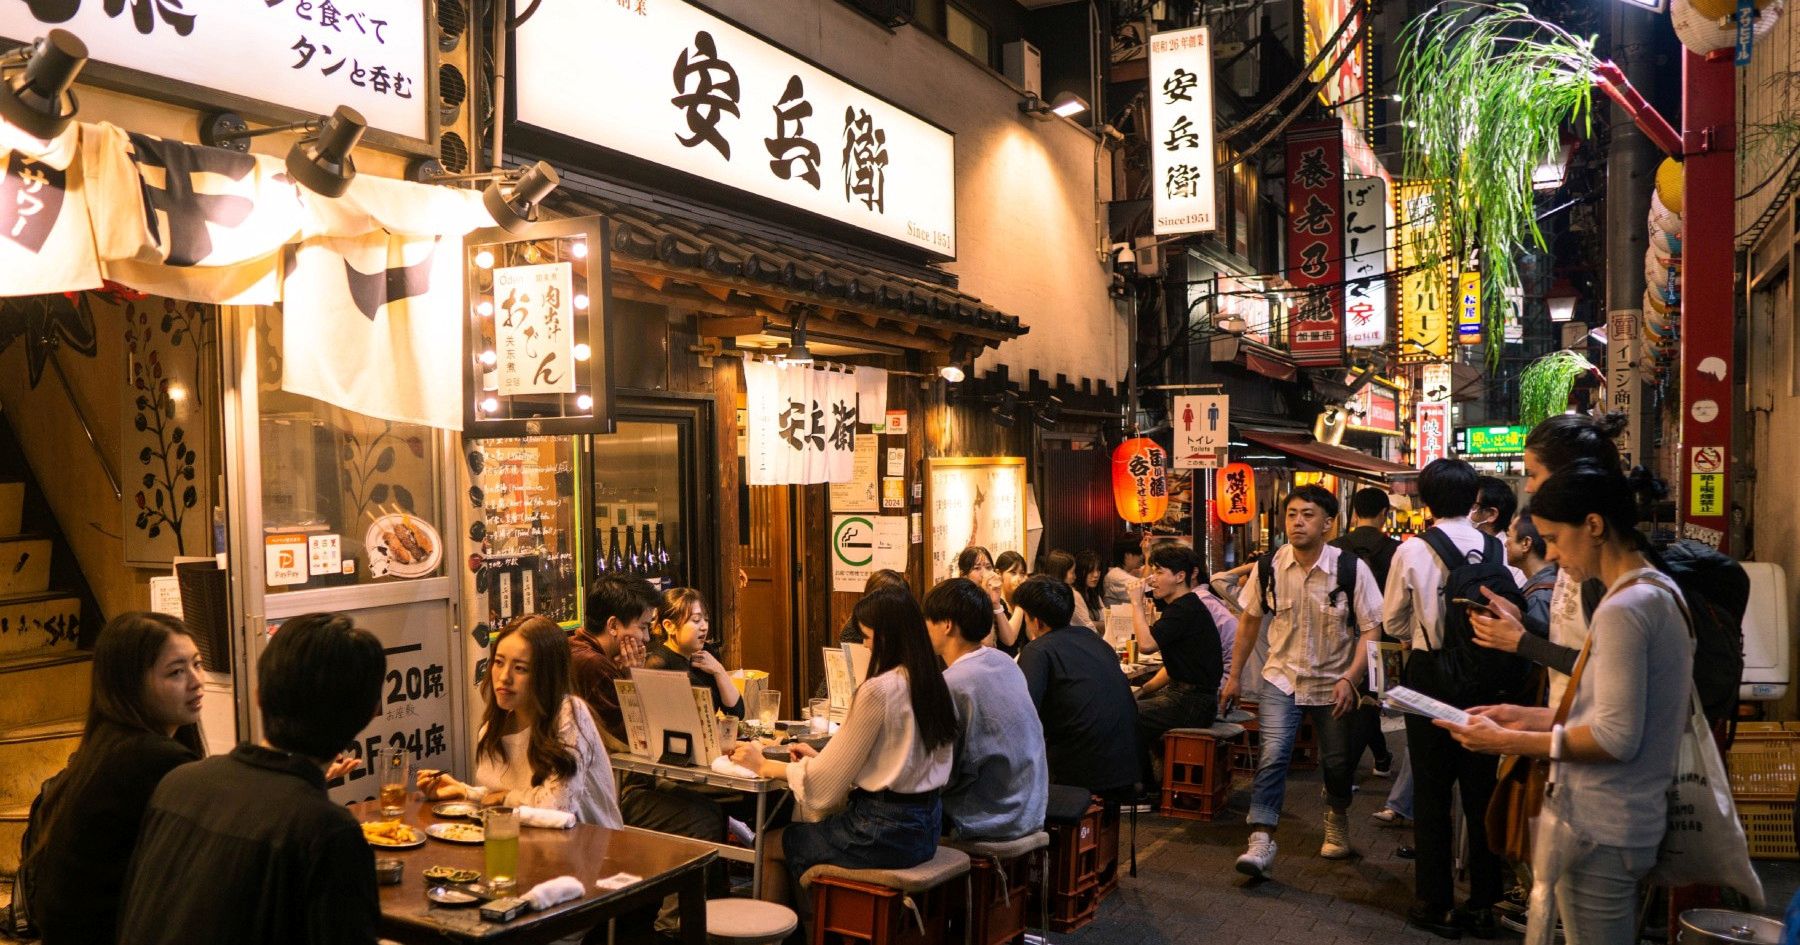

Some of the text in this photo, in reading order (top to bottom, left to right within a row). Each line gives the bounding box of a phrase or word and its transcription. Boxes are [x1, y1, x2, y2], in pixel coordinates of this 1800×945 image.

[265, 0, 388, 44] と食べて
[291, 35, 412, 98] タンと呑む
[671, 30, 888, 214] 安兵衛
[1163, 68, 1200, 200] 安兵衛
[10, 158, 50, 237] サワー
[907, 220, 951, 249] Since 1951
[501, 287, 566, 386] おでん
[778, 394, 857, 453] 安兵衛
[1187, 436, 1214, 445] トイレ
[884, 499, 901, 507] 2024
[386, 664, 444, 704] 20席
